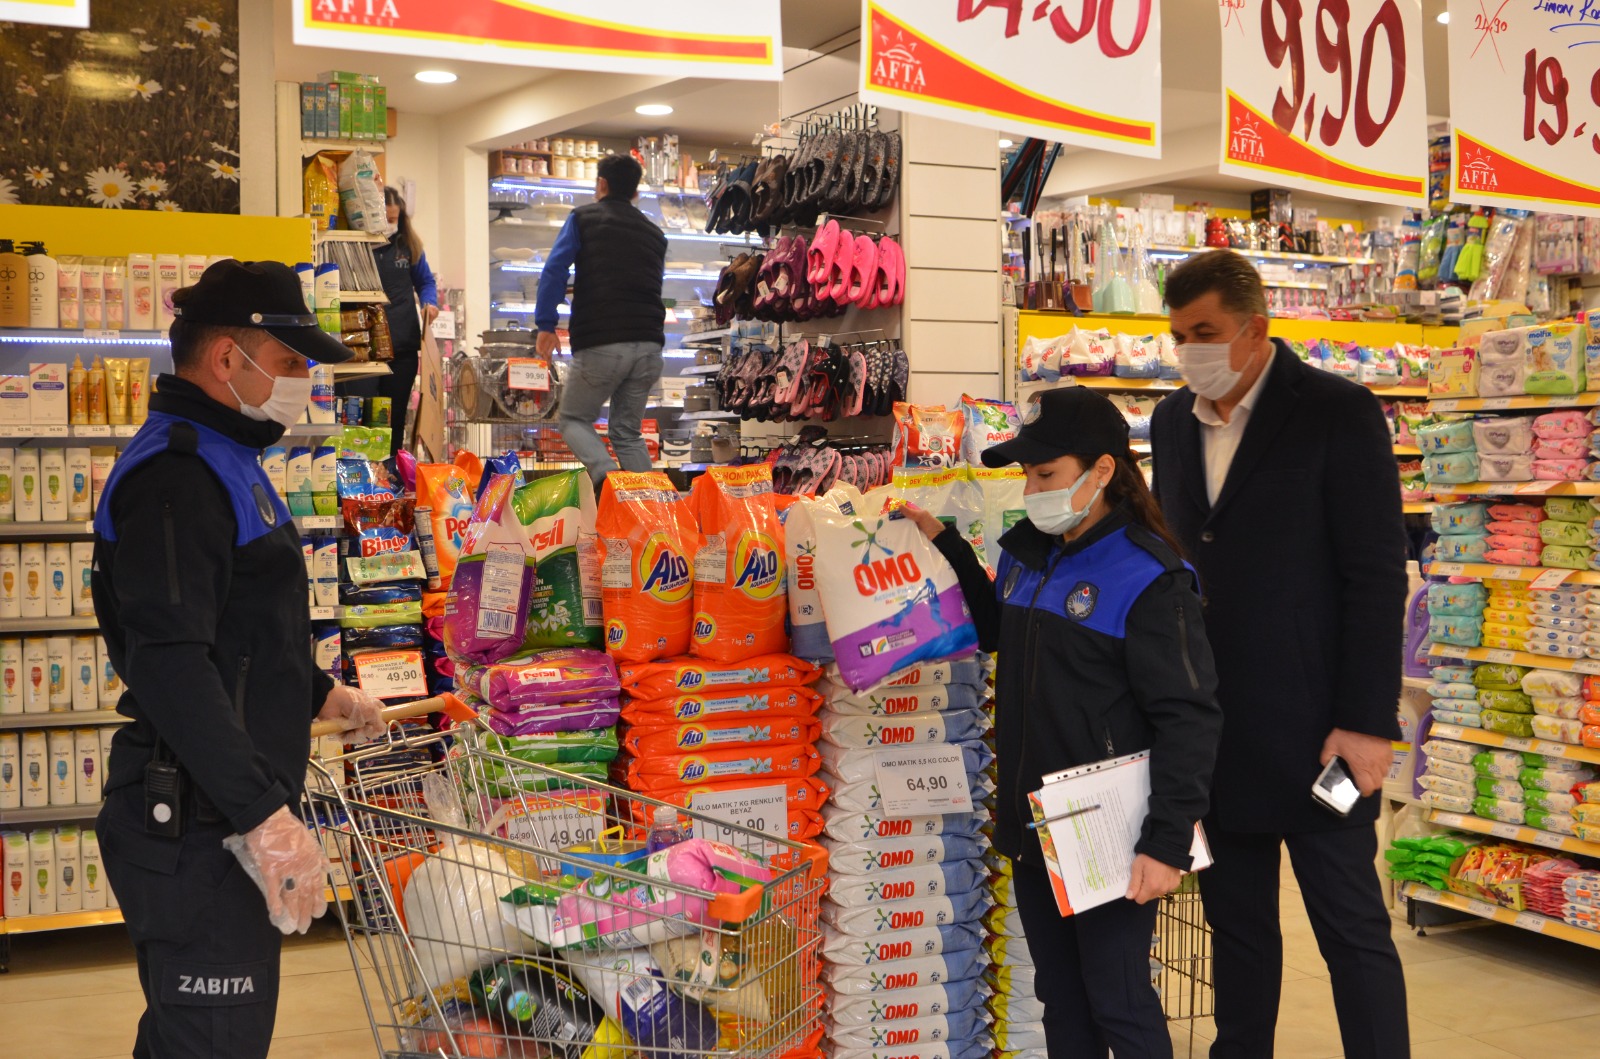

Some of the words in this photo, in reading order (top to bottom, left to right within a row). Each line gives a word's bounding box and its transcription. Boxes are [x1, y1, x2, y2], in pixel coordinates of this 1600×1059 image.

[323, 12, 395, 28] MARKET
[873, 58, 926, 86] AFTA
[1260, 0, 1406, 147] 9,90
[877, 78, 923, 94] MARKET
[1230, 137, 1265, 158] AFTA
[1232, 153, 1263, 164] MARKET
[1461, 170, 1498, 186] AFTA
[1463, 183, 1496, 191] MARKET
[1528, 331, 1552, 339] molfix
[361, 535, 409, 559] Bingo
[641, 551, 690, 593] ALO
[732, 548, 778, 590] ALO
[796, 555, 815, 590] OMO
[853, 551, 922, 597] OMO
[607, 627, 624, 643] ALO
[693, 622, 713, 637] ALO
[386, 669, 417, 682] 49,90
[677, 671, 703, 688] ALO
[677, 702, 701, 718] ALO
[886, 696, 919, 715] OMO
[678, 730, 704, 746] ALO
[881, 726, 915, 744] OMO
[899, 759, 917, 767] MATIK
[918, 758, 927, 766] 5,5
[680, 763, 705, 780] ALO
[906, 775, 948, 792] 64,90
[712, 802, 733, 810] MATIK
[730, 807, 752, 815] BEYAZ
[550, 828, 594, 846] 49,90
[878, 820, 912, 837] OMO
[880, 850, 914, 868] OMO
[882, 881, 915, 899] OMO
[891, 911, 924, 929] OMO
[879, 941, 912, 961] OMO
[178, 975, 255, 995] ZABITA
[885, 972, 918, 990] OMO
[885, 1003, 918, 1020] OMO
[887, 1029, 919, 1046] OMO
